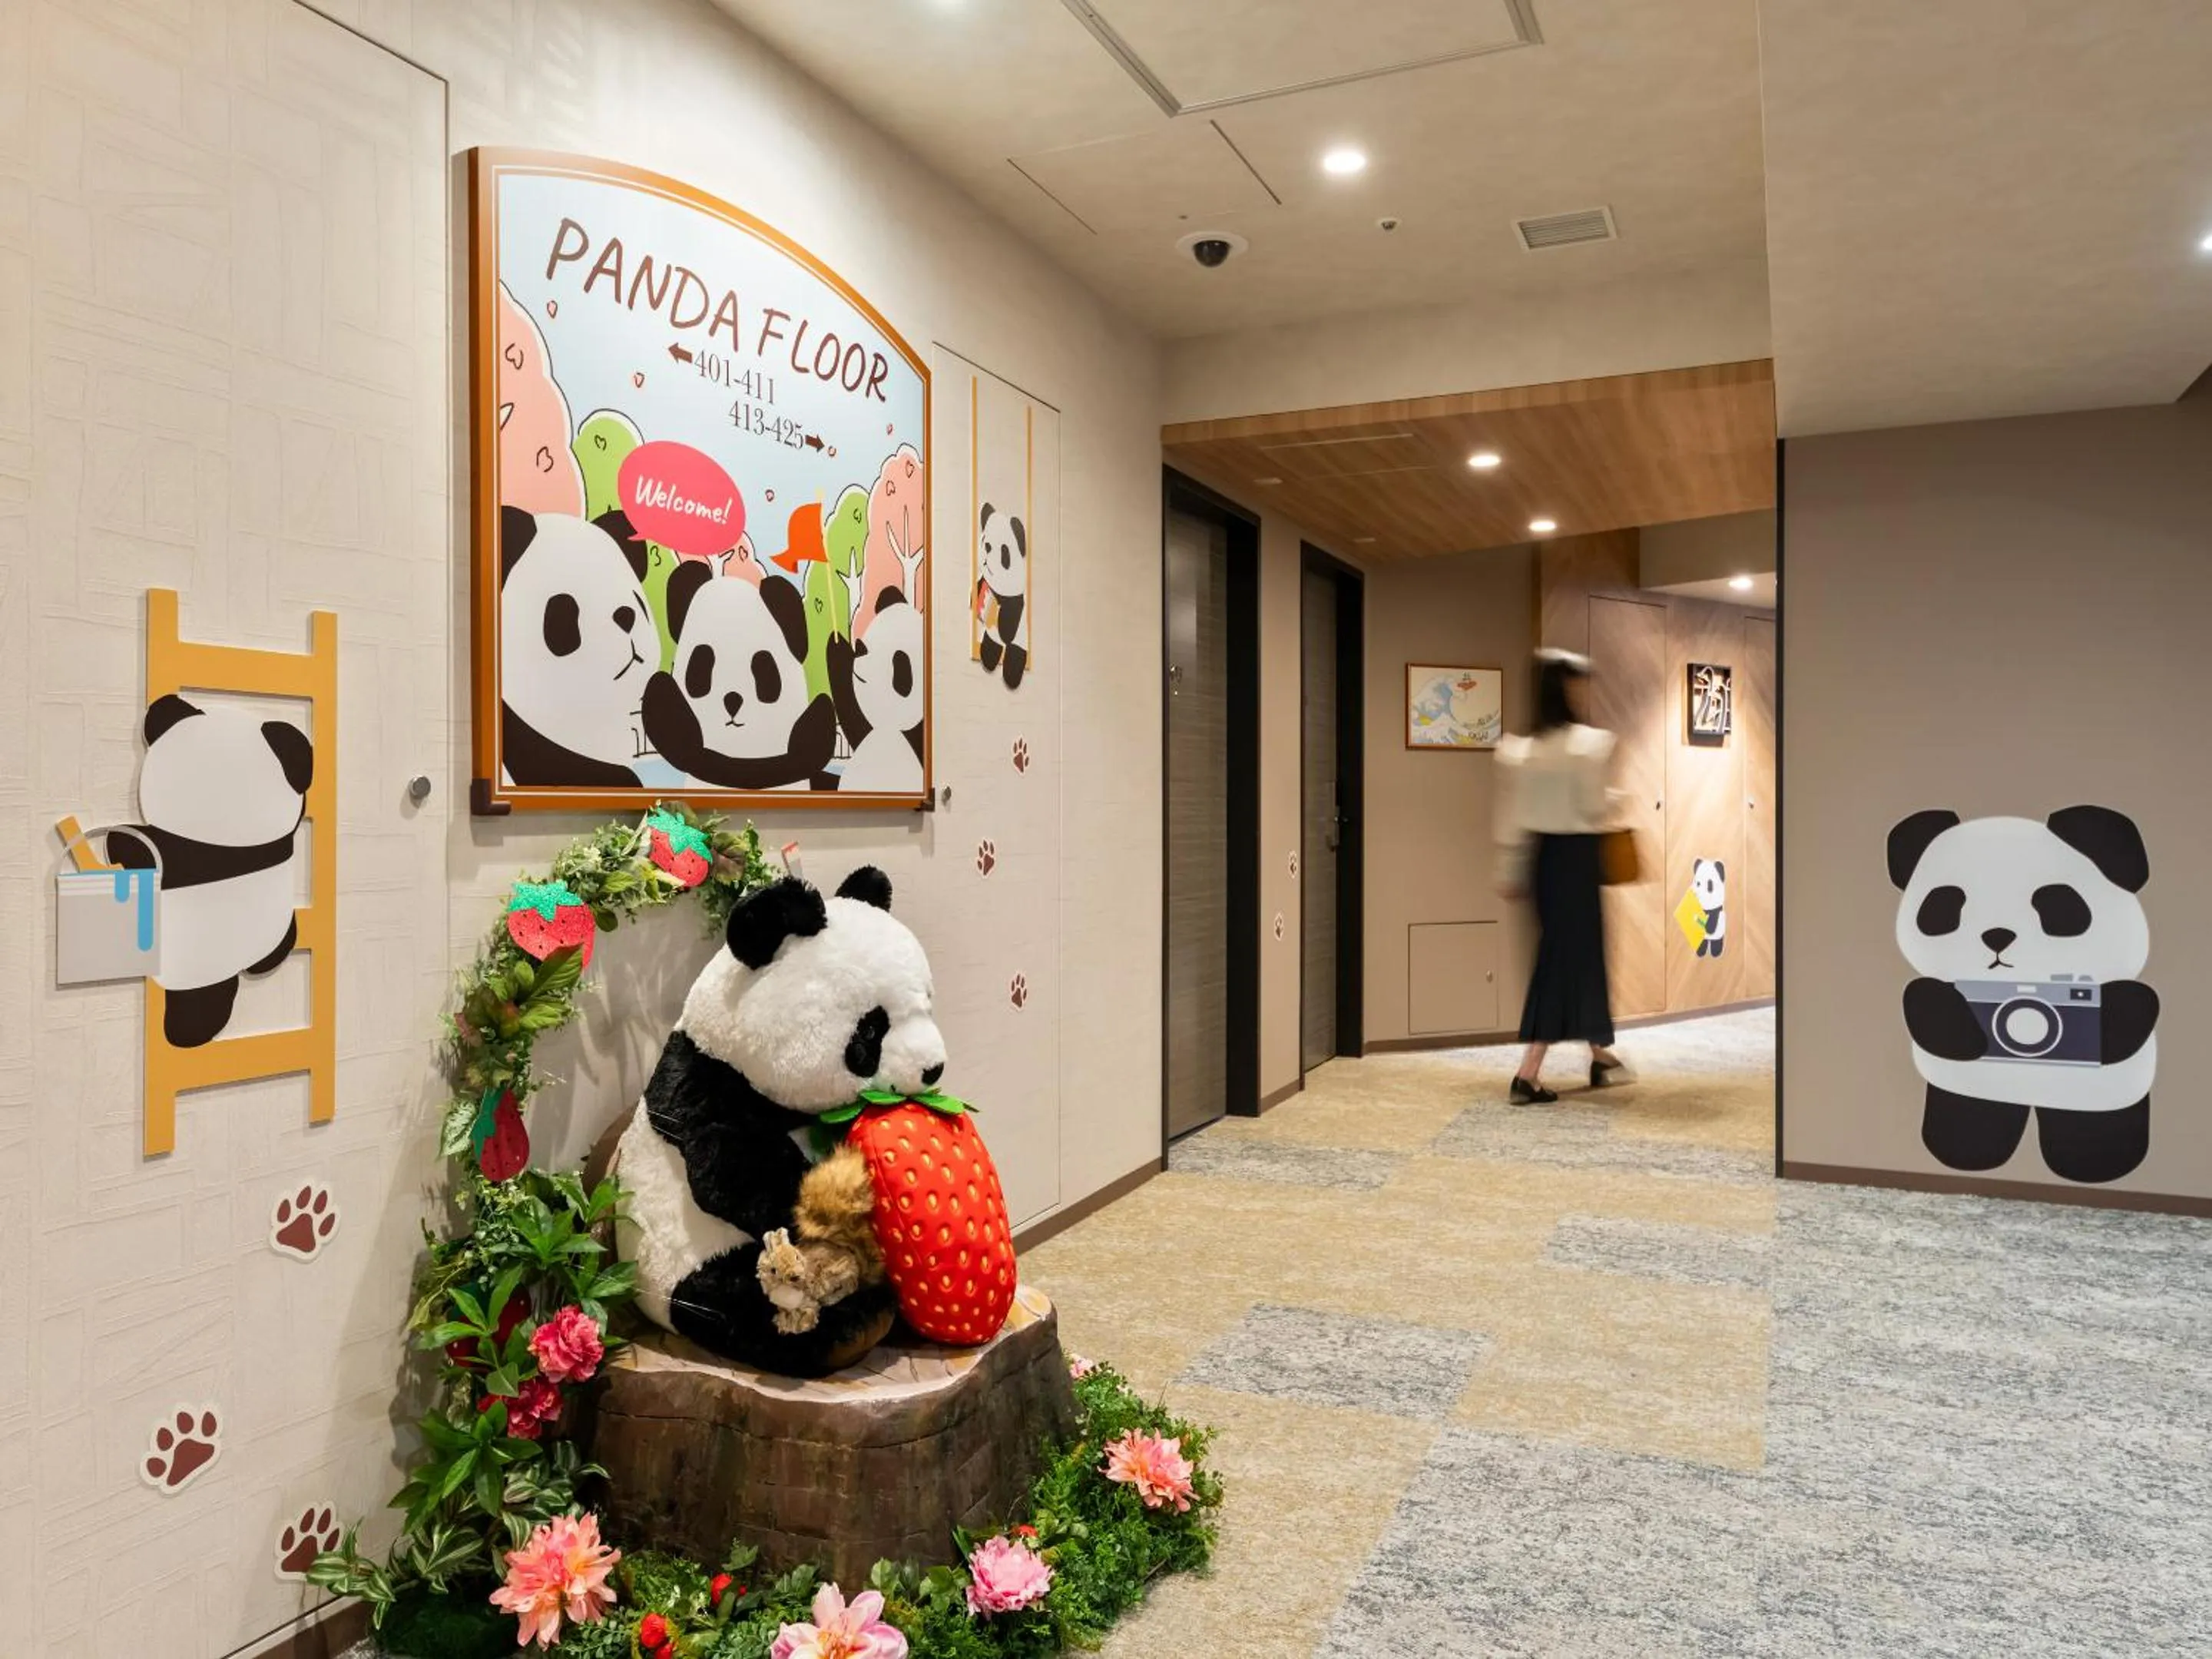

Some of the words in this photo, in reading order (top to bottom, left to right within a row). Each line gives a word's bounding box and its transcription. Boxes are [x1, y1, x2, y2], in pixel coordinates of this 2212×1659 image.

[546, 217, 740, 353] PANDA
[757, 308, 889, 402] FLOOR
[694, 350, 775, 405] 401-411
[729, 401, 804, 450] 413-425
[635, 475, 733, 525] Welcome!
